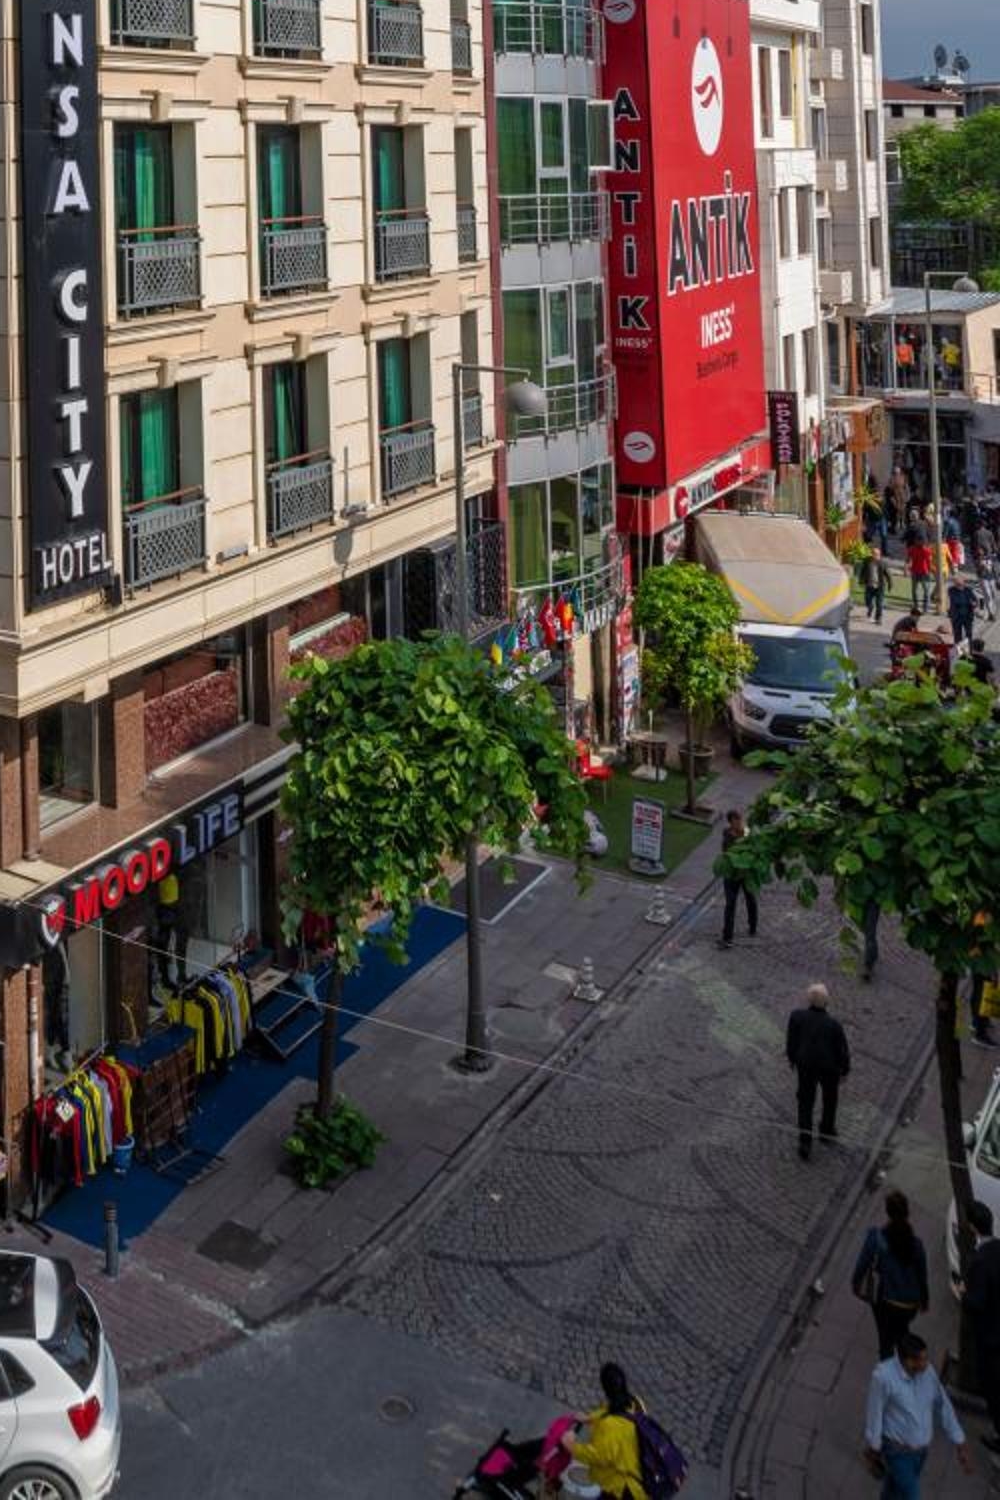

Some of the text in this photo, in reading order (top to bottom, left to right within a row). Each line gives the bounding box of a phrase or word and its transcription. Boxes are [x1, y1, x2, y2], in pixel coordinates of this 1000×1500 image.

[55, 268, 93, 518] CITY
[41, 532, 112, 590] HOTEL
[70, 793, 241, 929] MOOD LIFE
